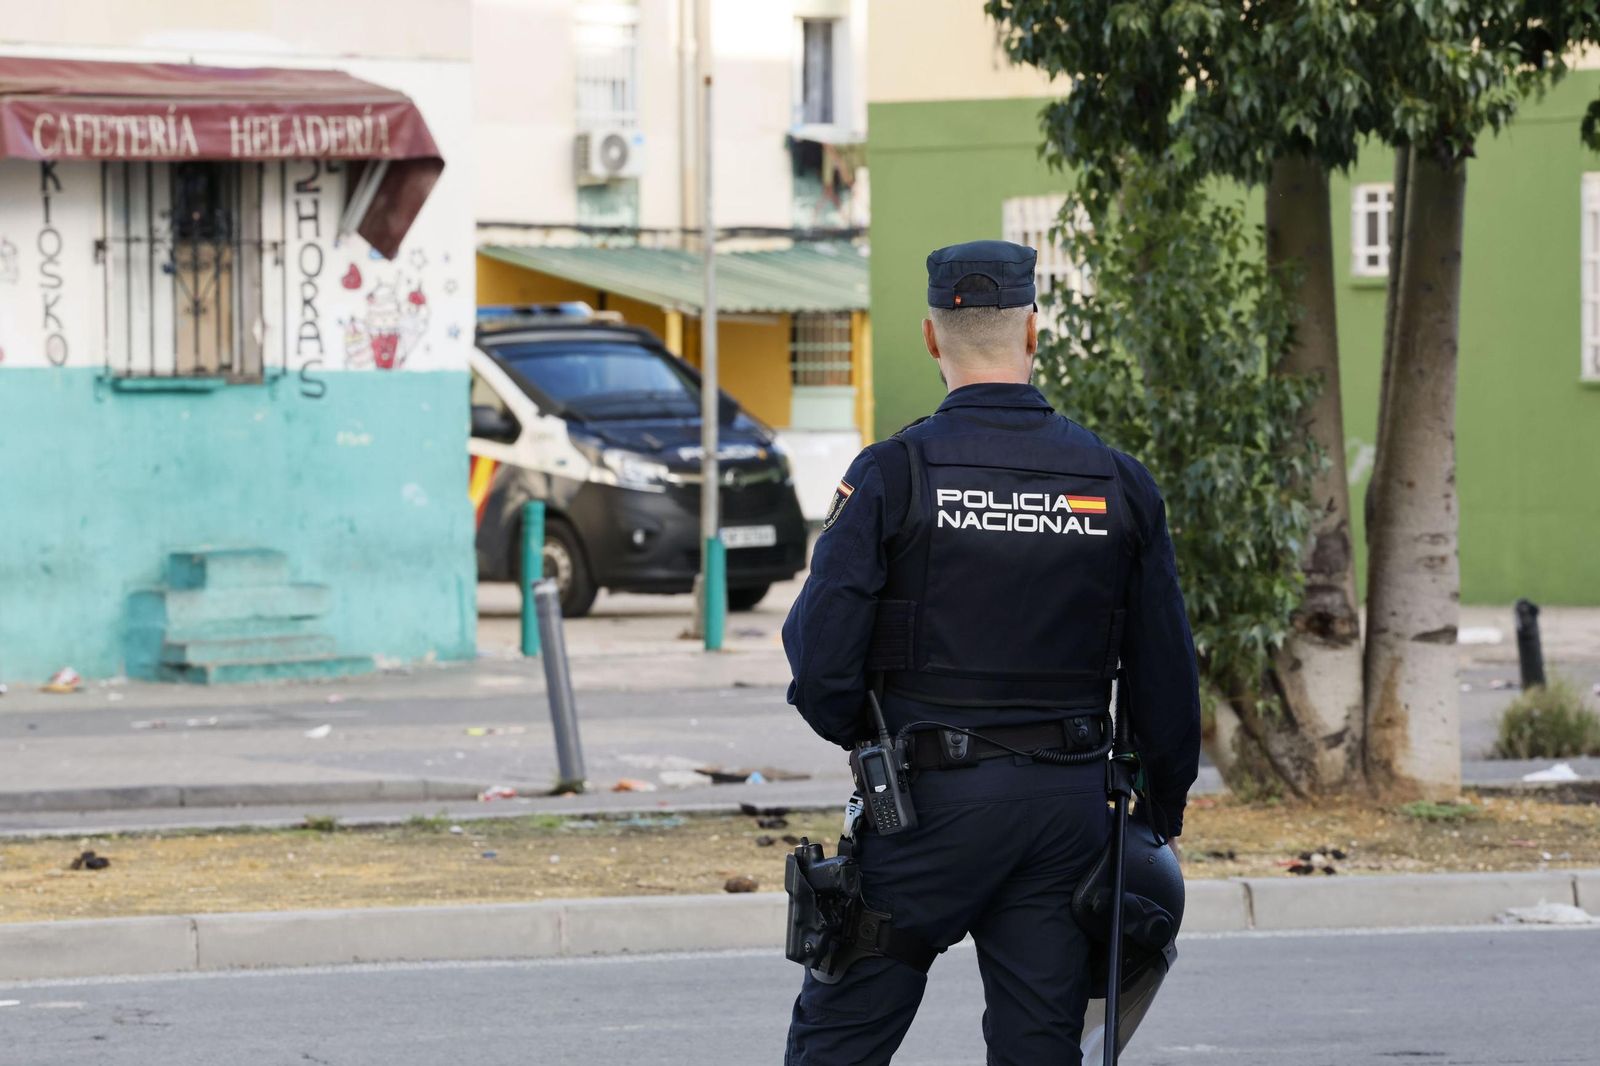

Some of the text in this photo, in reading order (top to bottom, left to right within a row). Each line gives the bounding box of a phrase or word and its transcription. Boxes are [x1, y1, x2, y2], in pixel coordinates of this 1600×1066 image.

[32, 103, 199, 156] CAFETERÍA
[37, 160, 68, 367] KIOSKO
[938, 510, 1108, 535] NACIONAL
